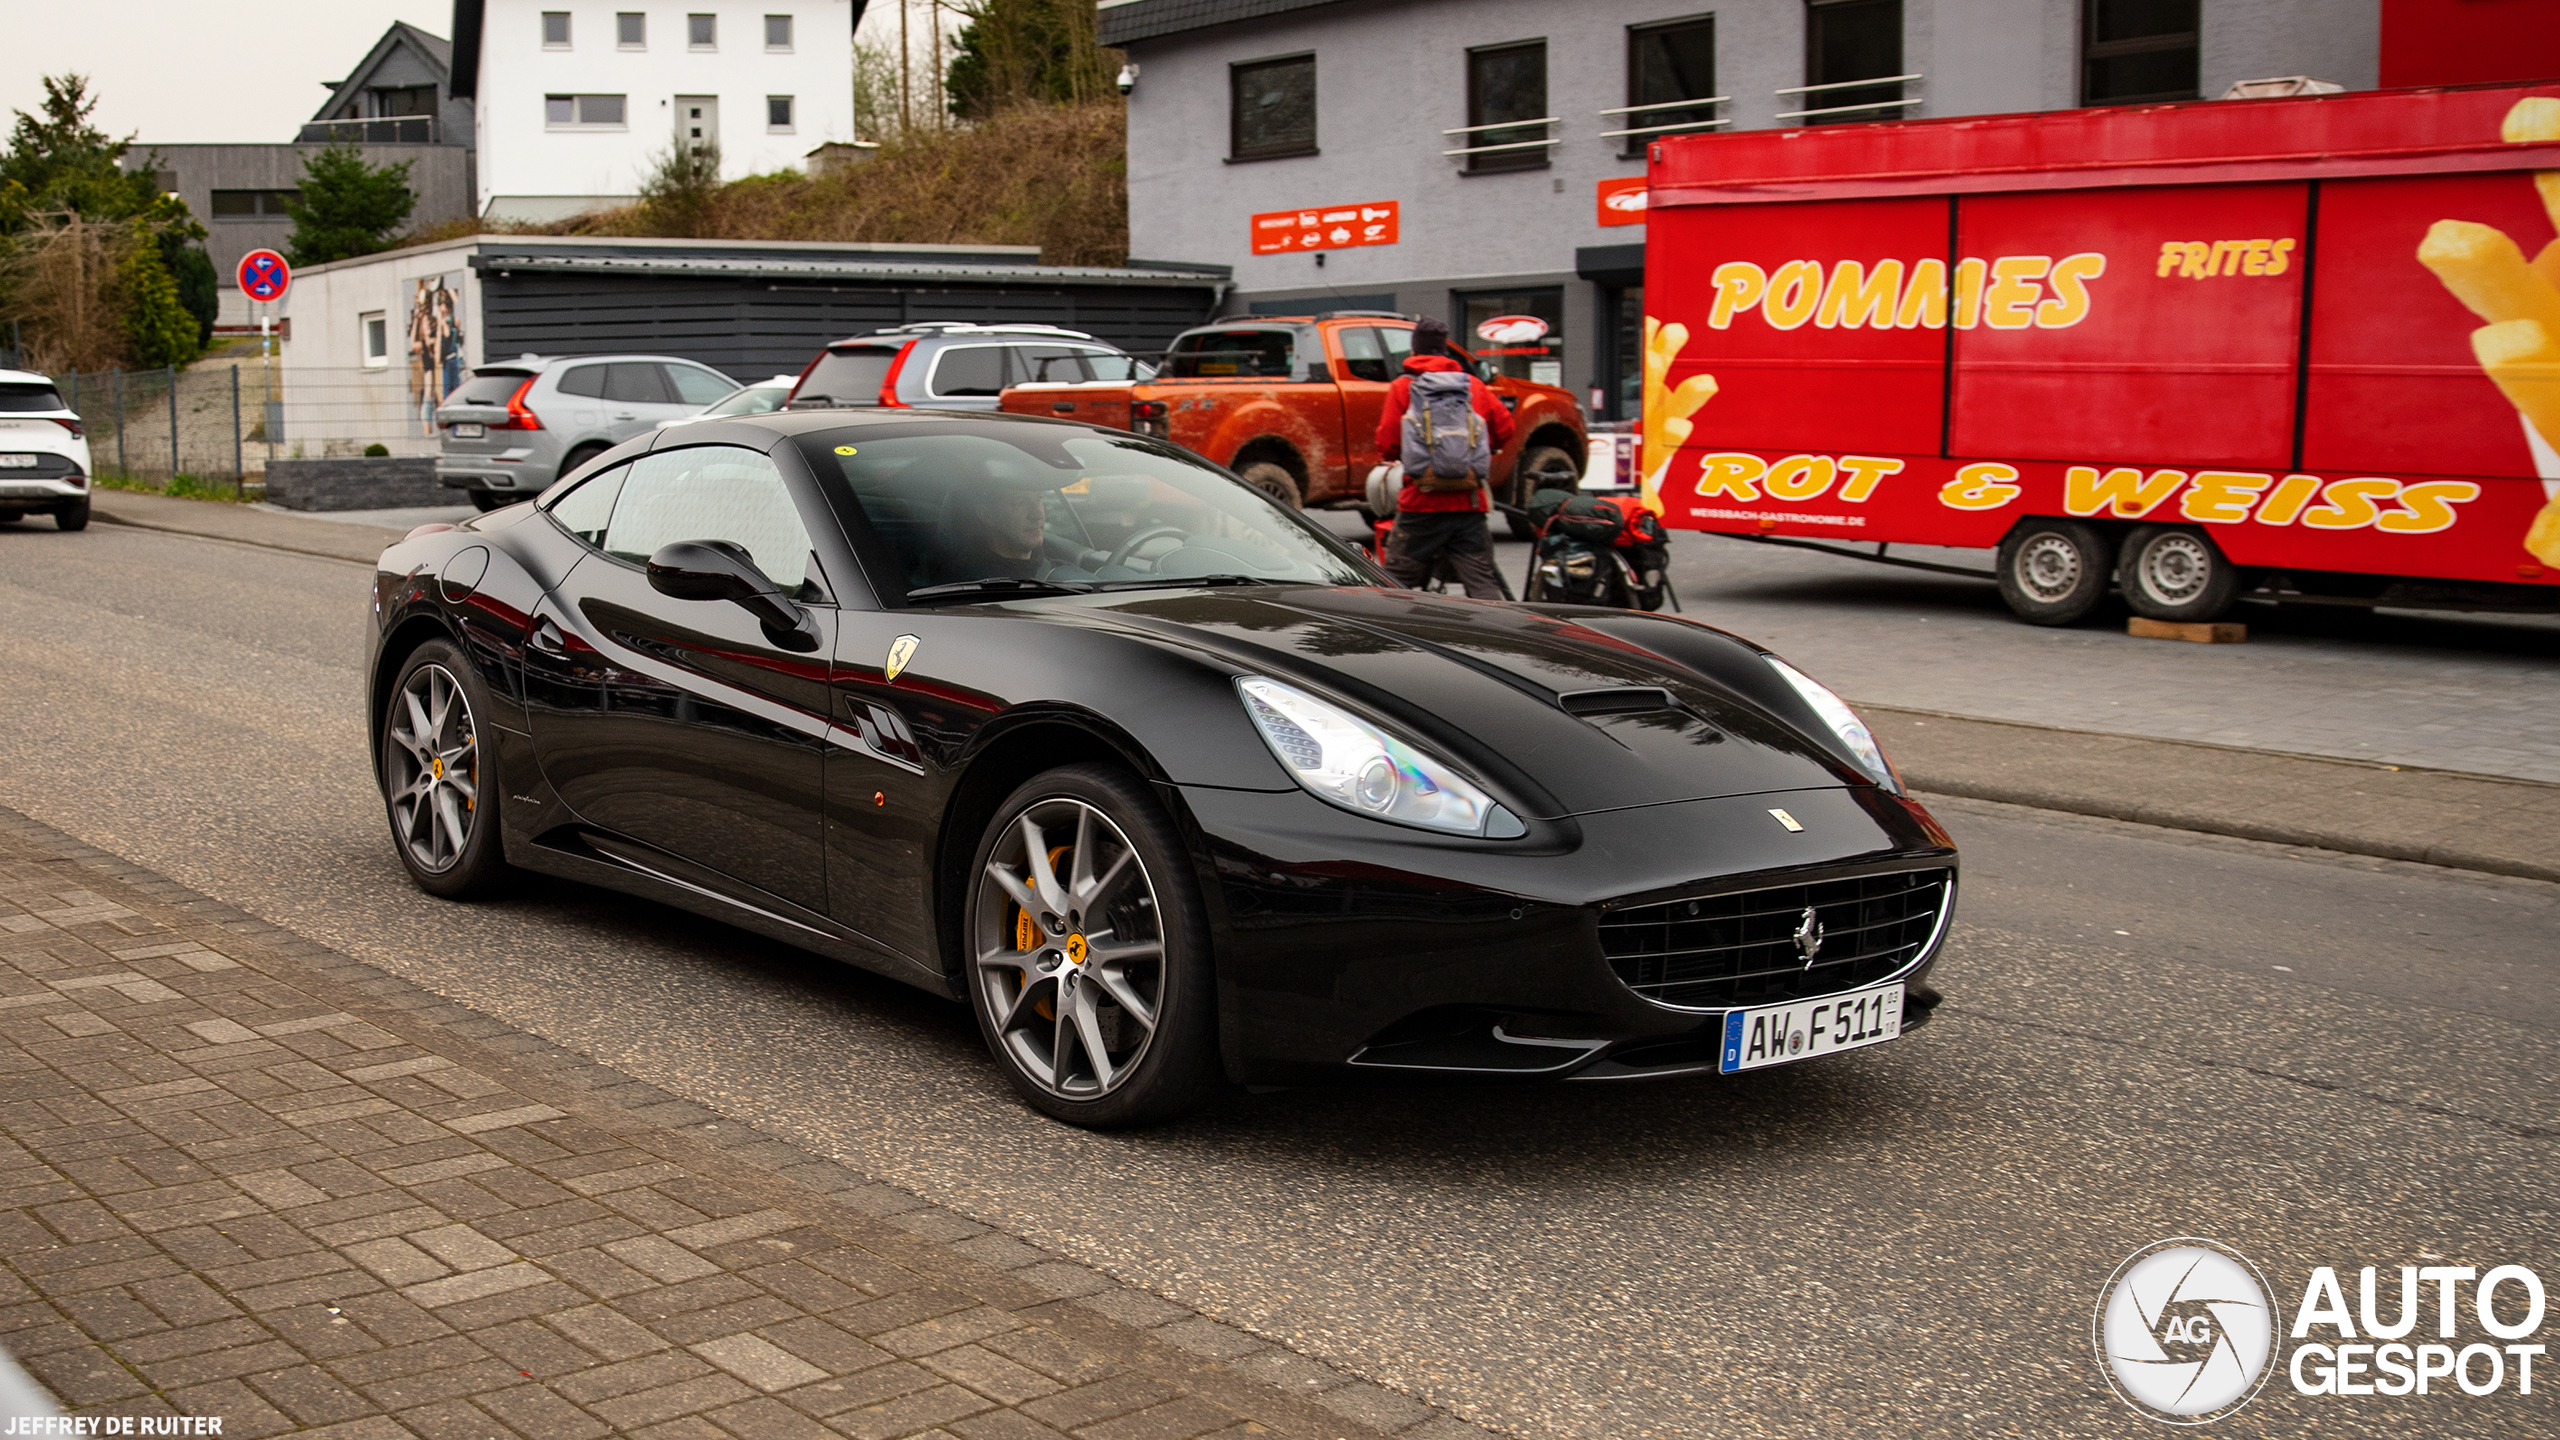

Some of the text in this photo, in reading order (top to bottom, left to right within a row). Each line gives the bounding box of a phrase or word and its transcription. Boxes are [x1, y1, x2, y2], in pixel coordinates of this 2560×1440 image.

[2157, 238, 2296, 282] FRITES
[1708, 252, 2107, 330] POMMES
[1689, 507, 1866, 527] WEISSBACH-GASTRONOMIE.DE
[1695, 452, 2480, 534] ROT & WEISS
[1727, 1048, 1737, 1062] D
[1747, 993, 1884, 1062] AW F 511
